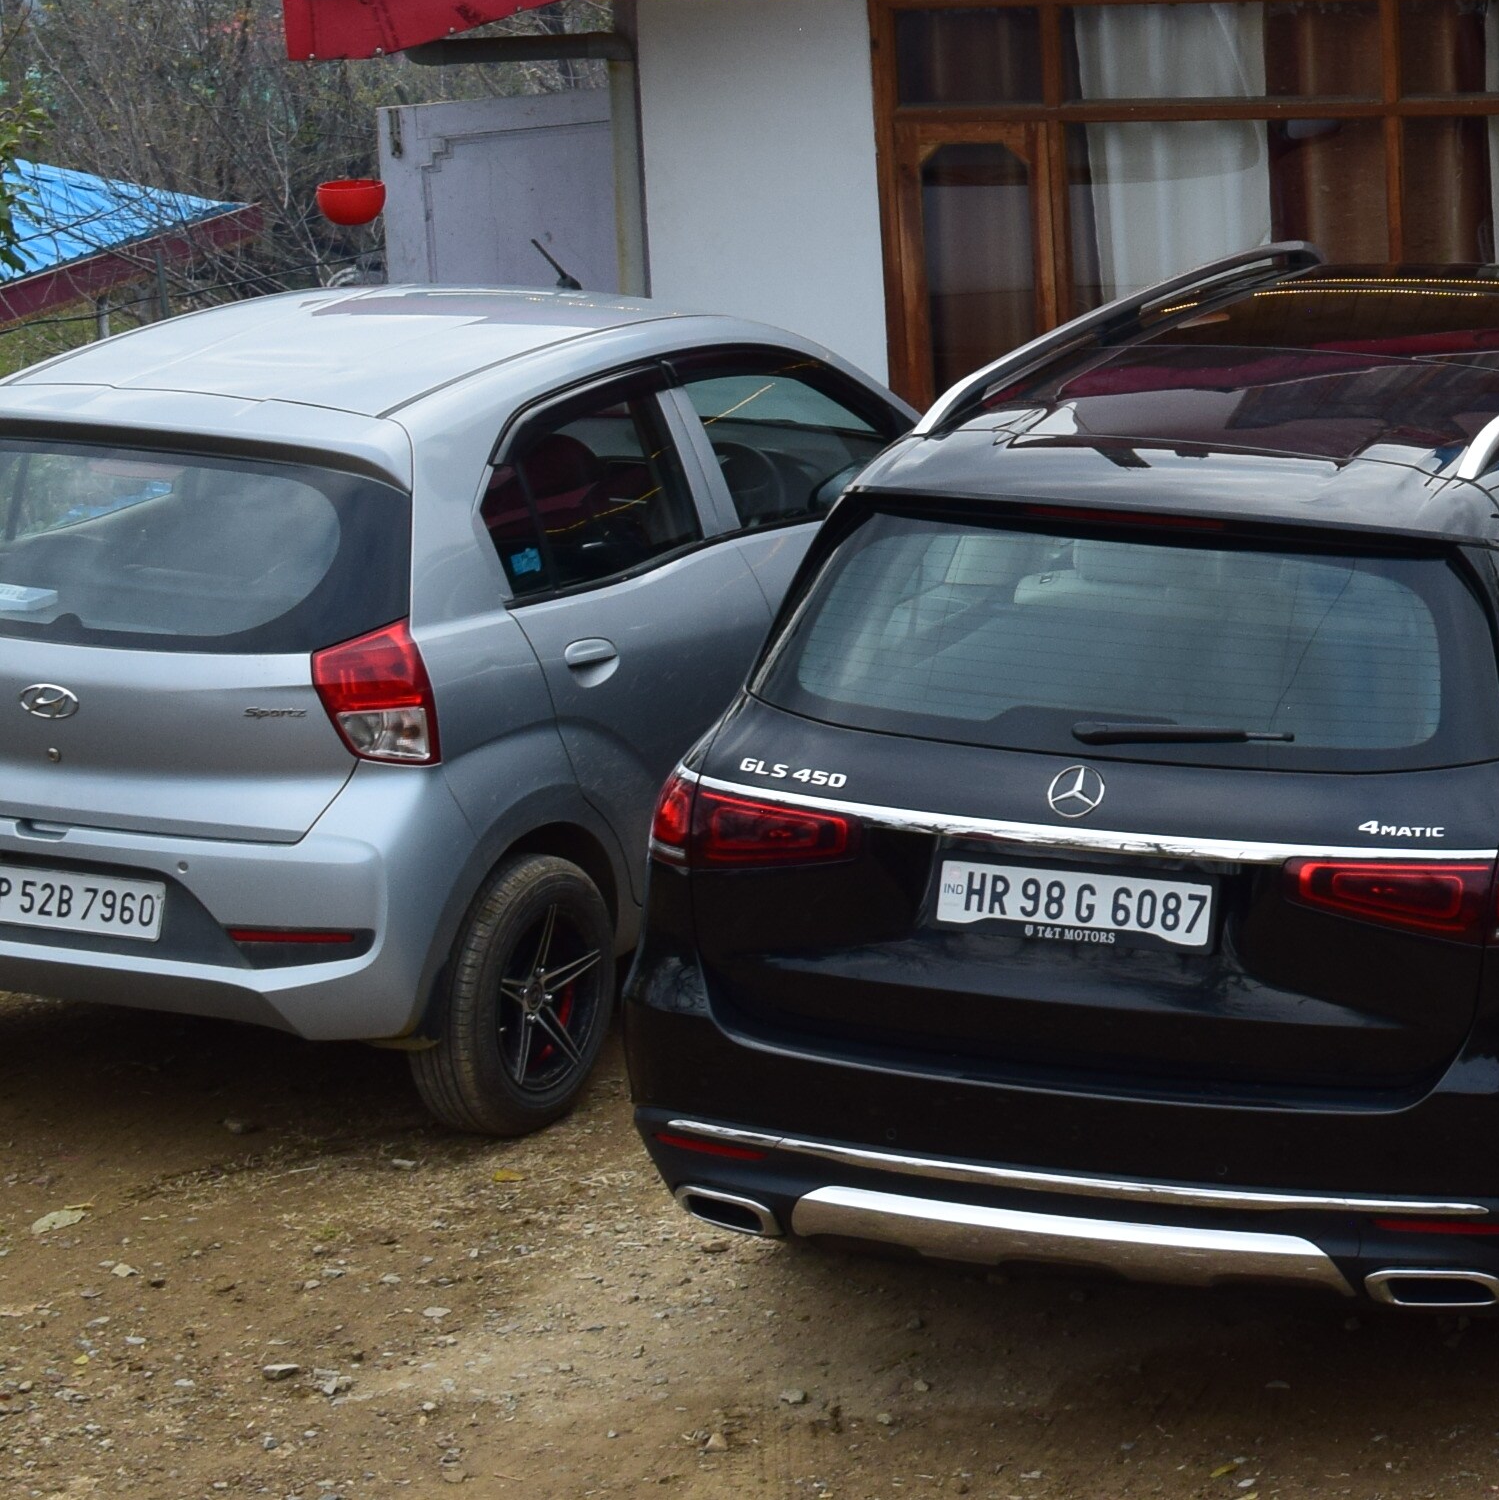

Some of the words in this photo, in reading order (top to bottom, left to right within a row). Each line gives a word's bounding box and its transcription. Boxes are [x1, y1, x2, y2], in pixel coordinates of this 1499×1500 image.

[243, 706, 307, 720] Sportz
[739, 757, 790, 779] GLS
[792, 768, 848, 789] 450
[1357, 820, 1446, 838] 4MATIC
[943, 883, 965, 896] IND
[80, 886, 156, 927] 7960
[963, 871, 1011, 916] HR
[1019, 877, 1066, 921] 98
[1074, 883, 1098, 924] G
[1110, 886, 1209, 934] 6087
[1036, 925, 1062, 940] T&T
[1063, 929, 1116, 944] MOTORS
